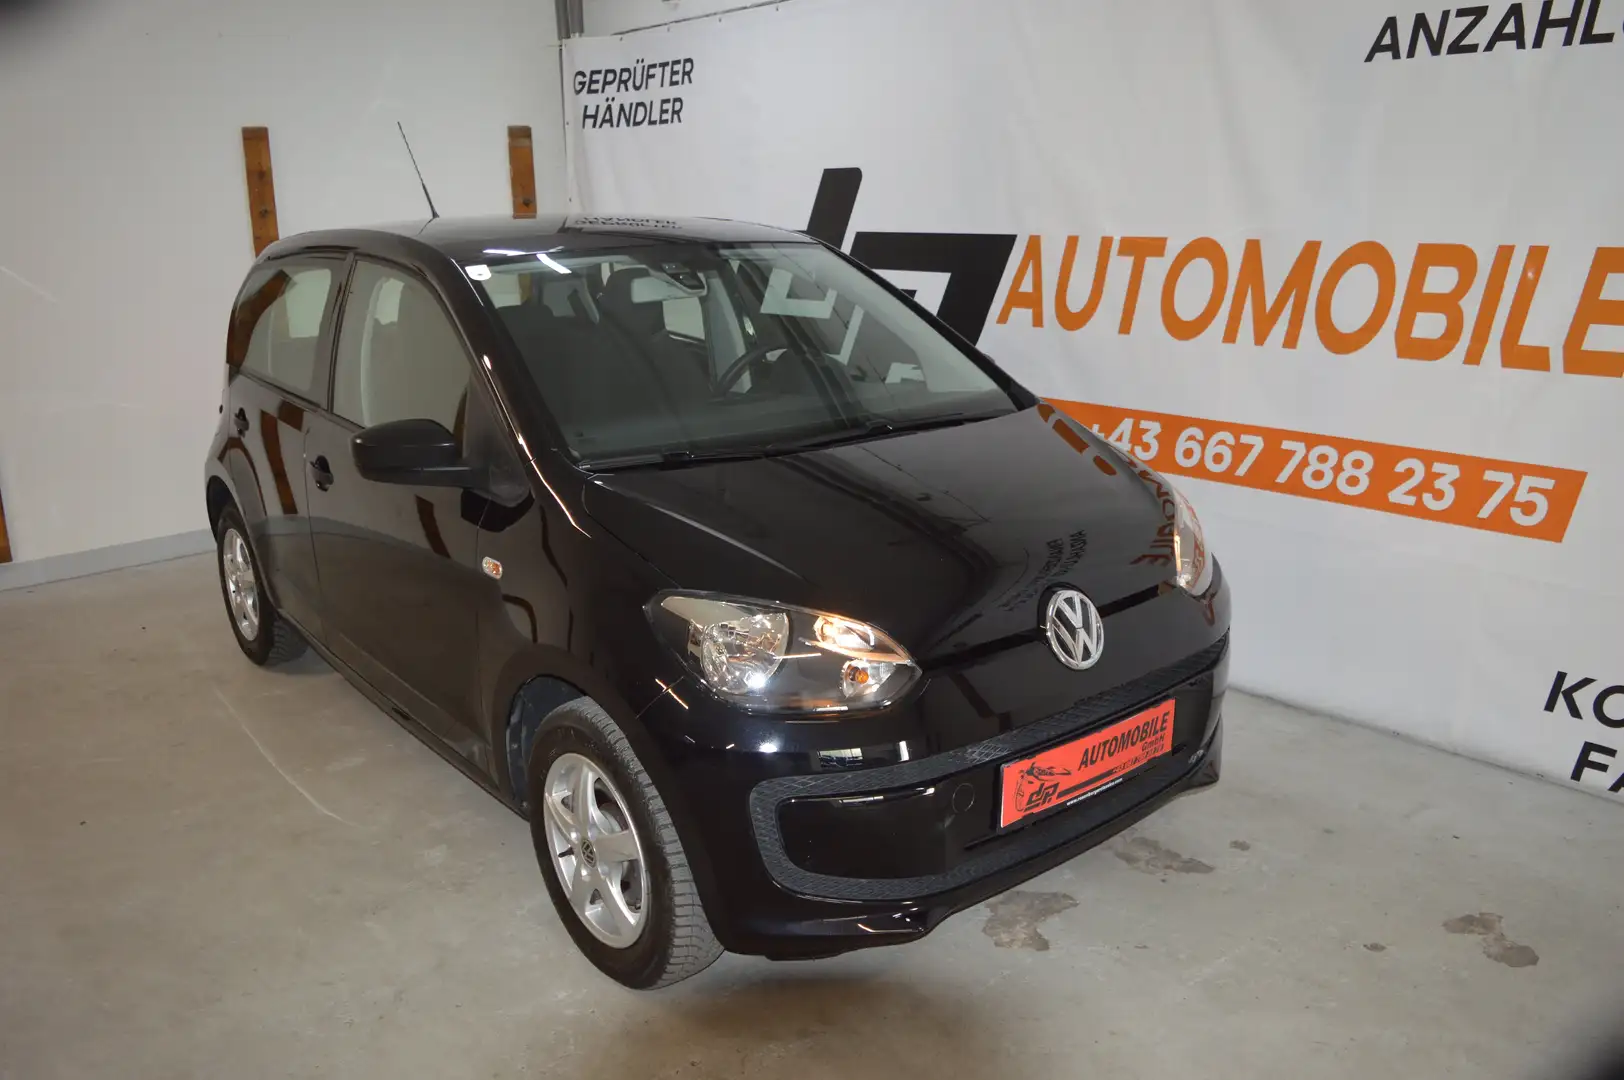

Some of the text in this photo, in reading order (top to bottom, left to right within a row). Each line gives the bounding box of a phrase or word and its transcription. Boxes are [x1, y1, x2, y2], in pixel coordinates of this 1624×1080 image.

[1364, 0, 1624, 62] ANZAHL
[574, 57, 693, 95] GEPRÜFTER
[583, 97, 682, 129] HÄNDLER
[997, 235, 1624, 378] AUTOMOBILE
[1174, 427, 1263, 476] 667
[1275, 442, 1373, 495] 788
[1388, 459, 1460, 511] 23
[1477, 472, 1556, 526] 75
[1078, 712, 1170, 771] AUTOMOBILE
